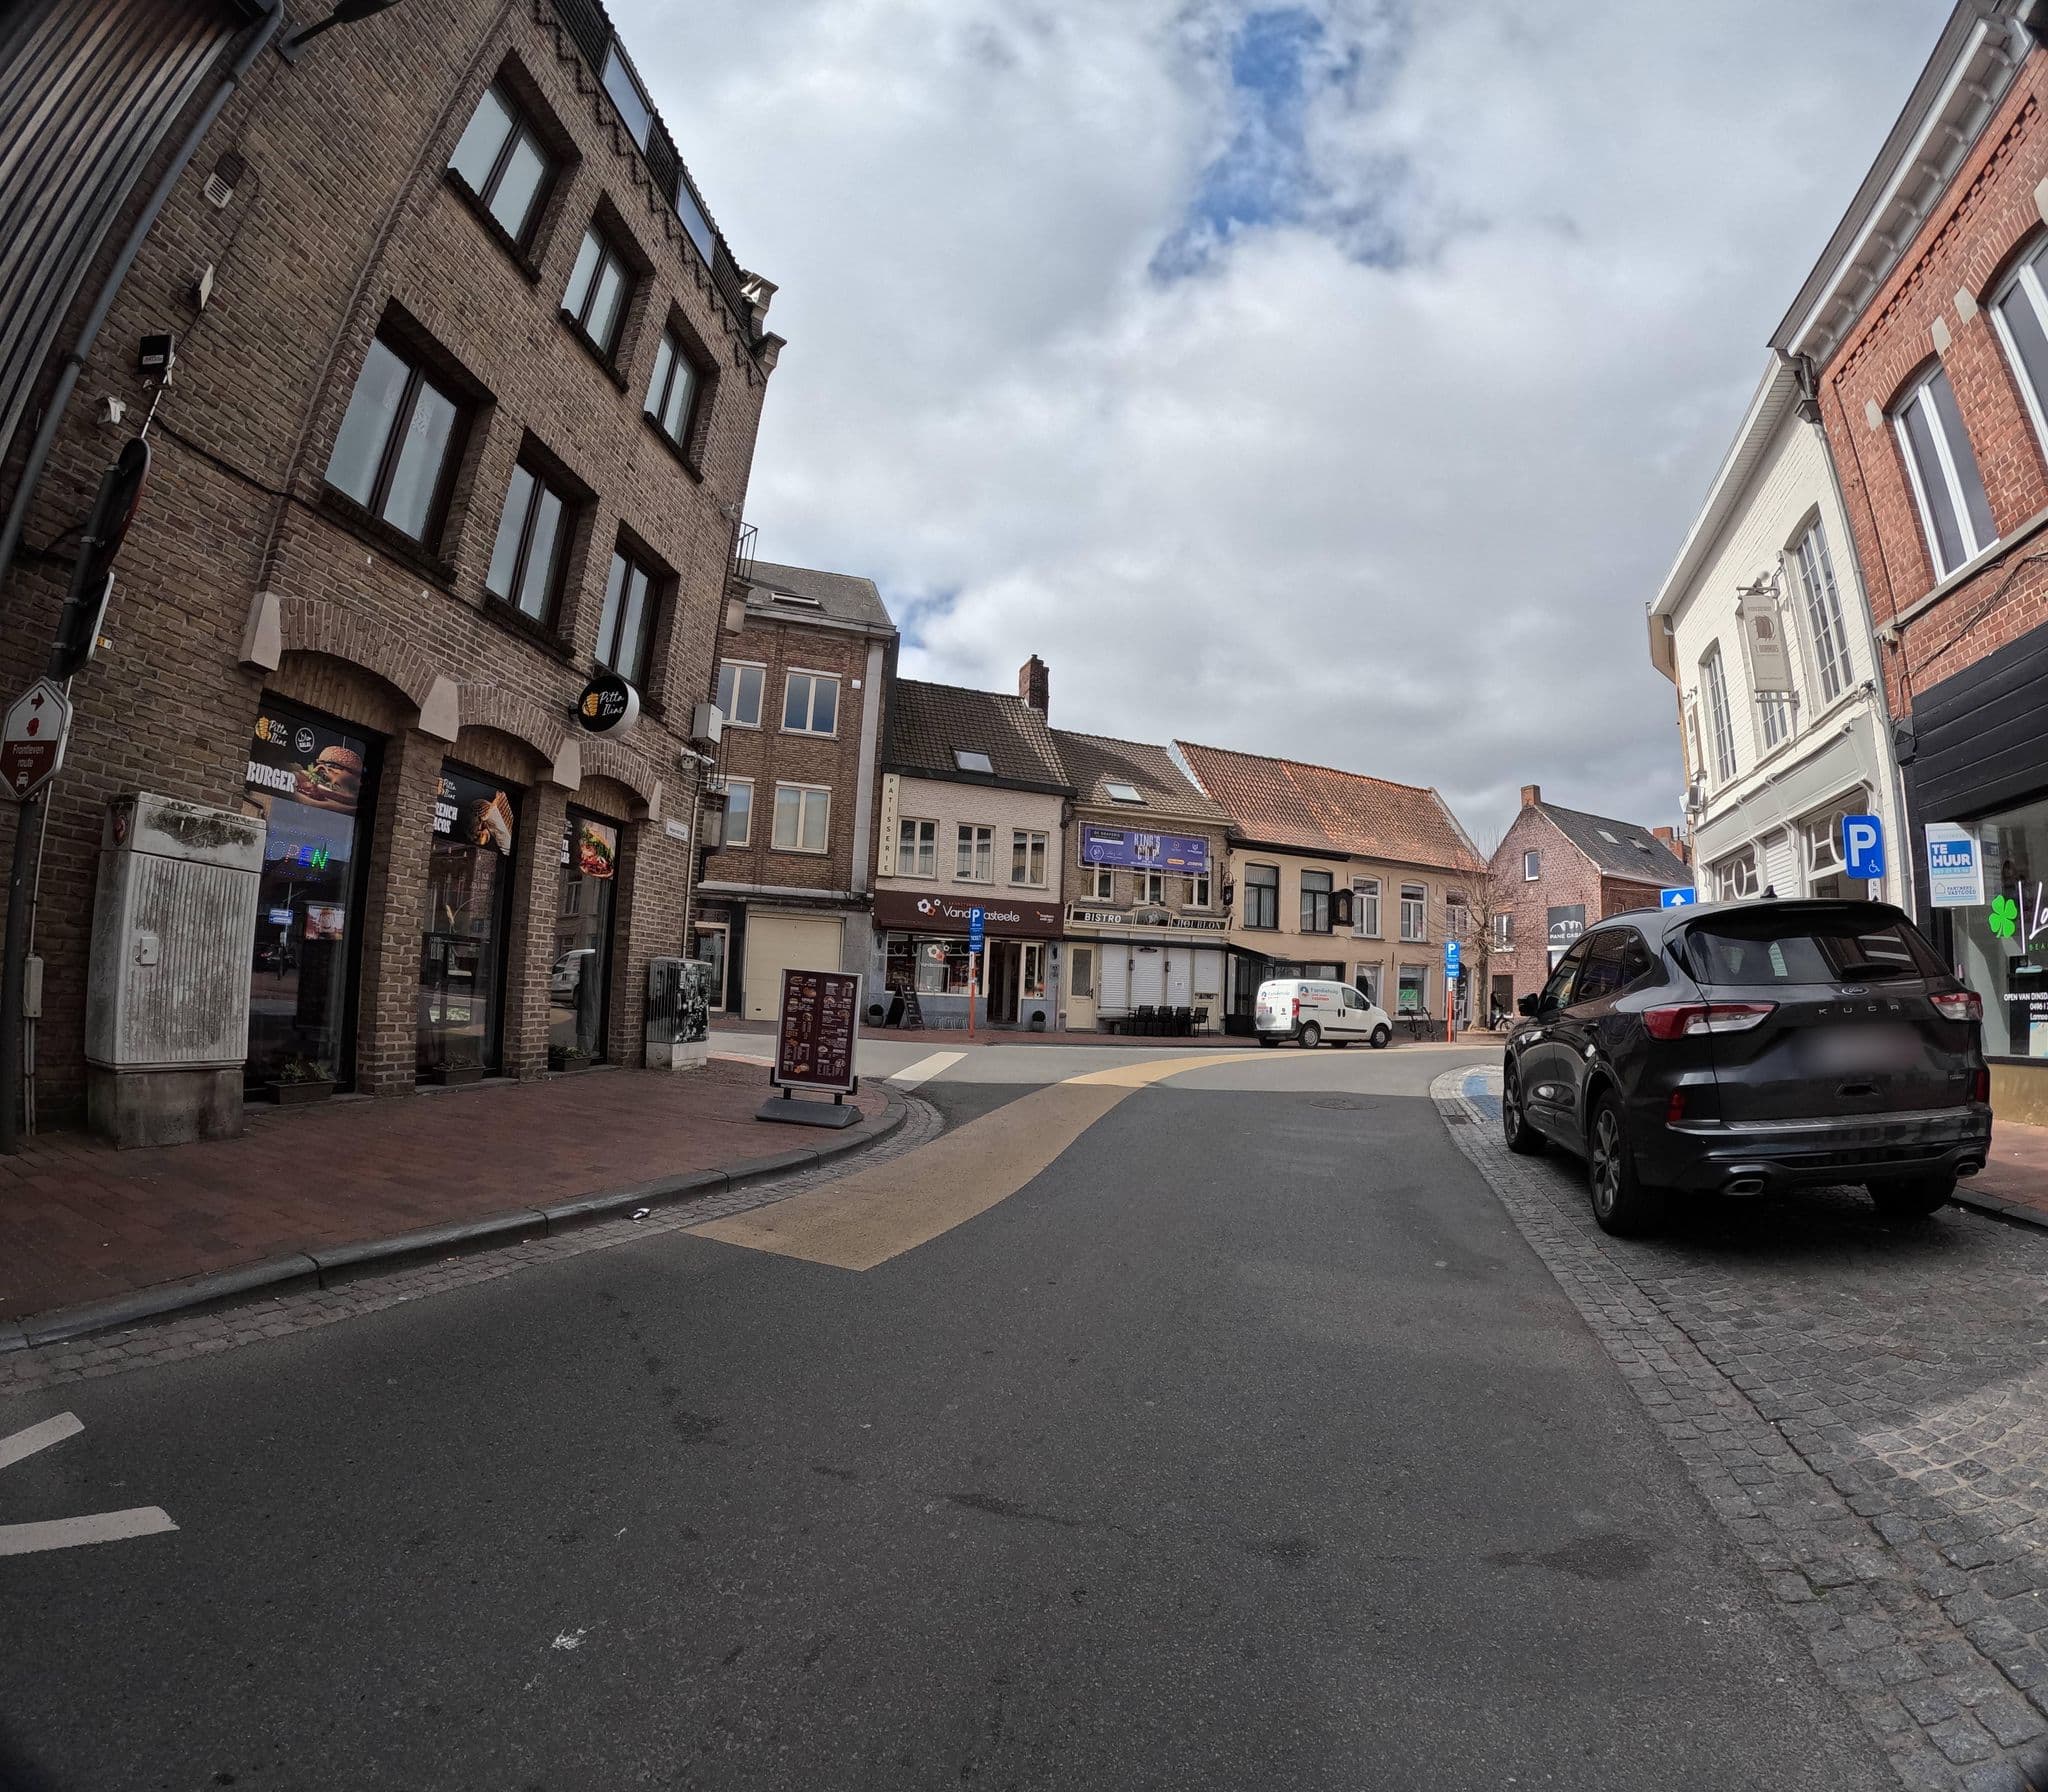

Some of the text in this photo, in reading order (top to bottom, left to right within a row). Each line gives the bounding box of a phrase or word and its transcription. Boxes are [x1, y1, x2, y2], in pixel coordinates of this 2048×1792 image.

[600, 690, 625, 703] Pitta
[601, 703, 624, 717] Ilias
[268, 719, 288, 736] Pitta
[17, 759, 33, 768] route
[246, 760, 297, 793] BURGER
[435, 802, 458, 821] RENCH
[433, 816, 451, 834] ACOS
[884, 778, 894, 872] PATISSERIE
[1133, 833, 1160, 849] KING'S
[1849, 824, 1877, 867] P
[270, 841, 328, 870] OPEN
[1931, 843, 1948, 854] TE
[1932, 853, 1971, 867] HUUR
[943, 904, 1021, 923] Vandasteele
[972, 909, 980, 923] P
[1084, 912, 1121, 924] BISTRO
[1448, 944, 1456, 955] P
[2003, 993, 2017, 1001] OPEN
[2031, 992, 2048, 1000] DINSD
[1818, 1004, 1899, 1015] KUGA
